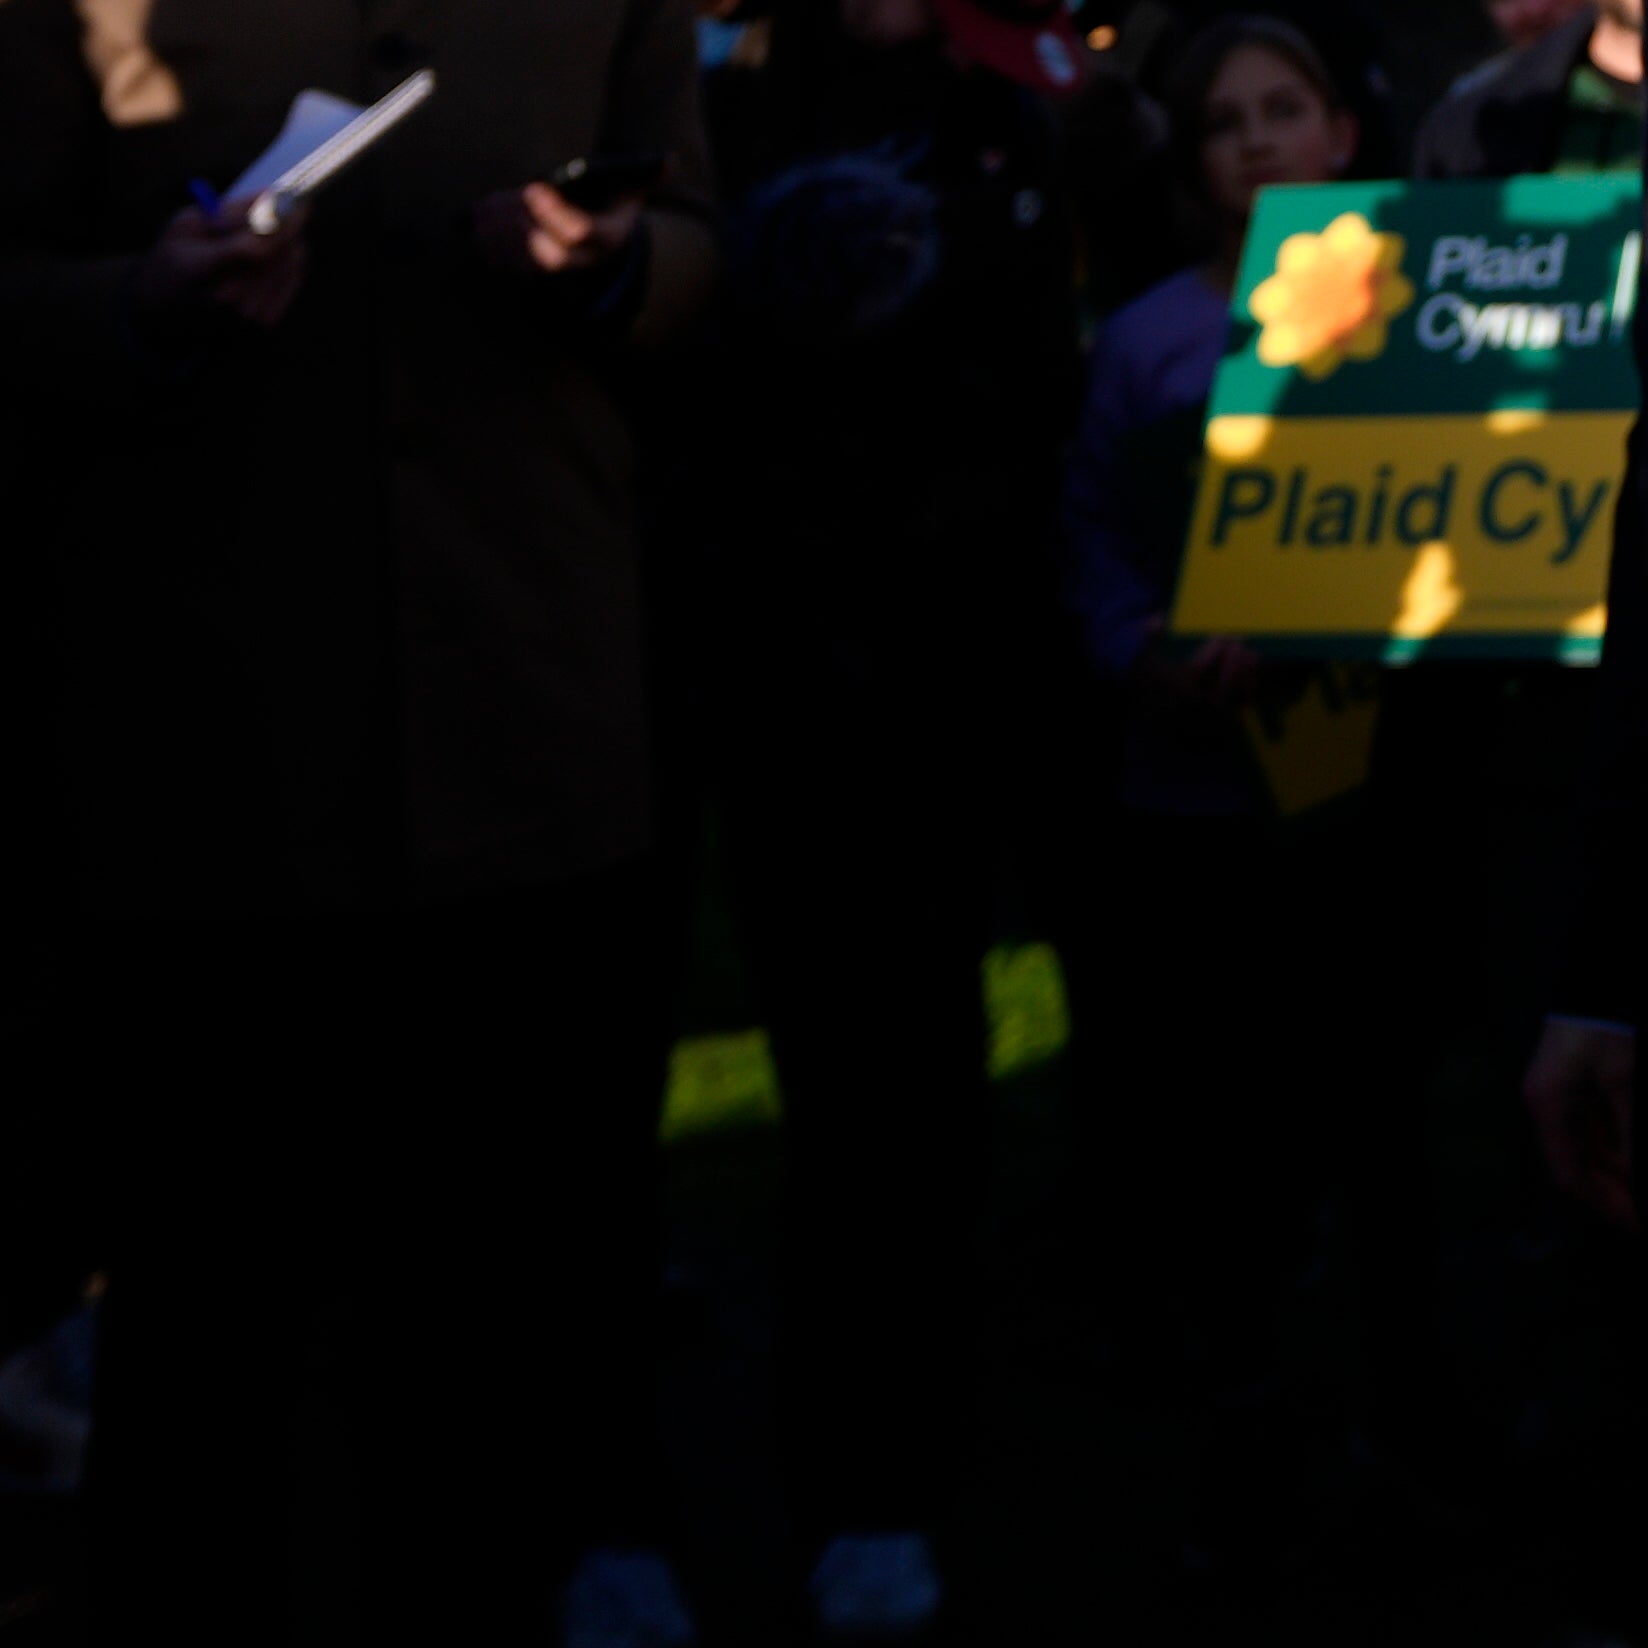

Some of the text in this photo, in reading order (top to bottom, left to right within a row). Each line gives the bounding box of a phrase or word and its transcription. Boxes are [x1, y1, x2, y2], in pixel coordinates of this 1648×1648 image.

[1427, 235, 1568, 289] Plaid
[1416, 294, 1600, 360] Cymru
[1210, 457, 1609, 565] Plaid Cy
